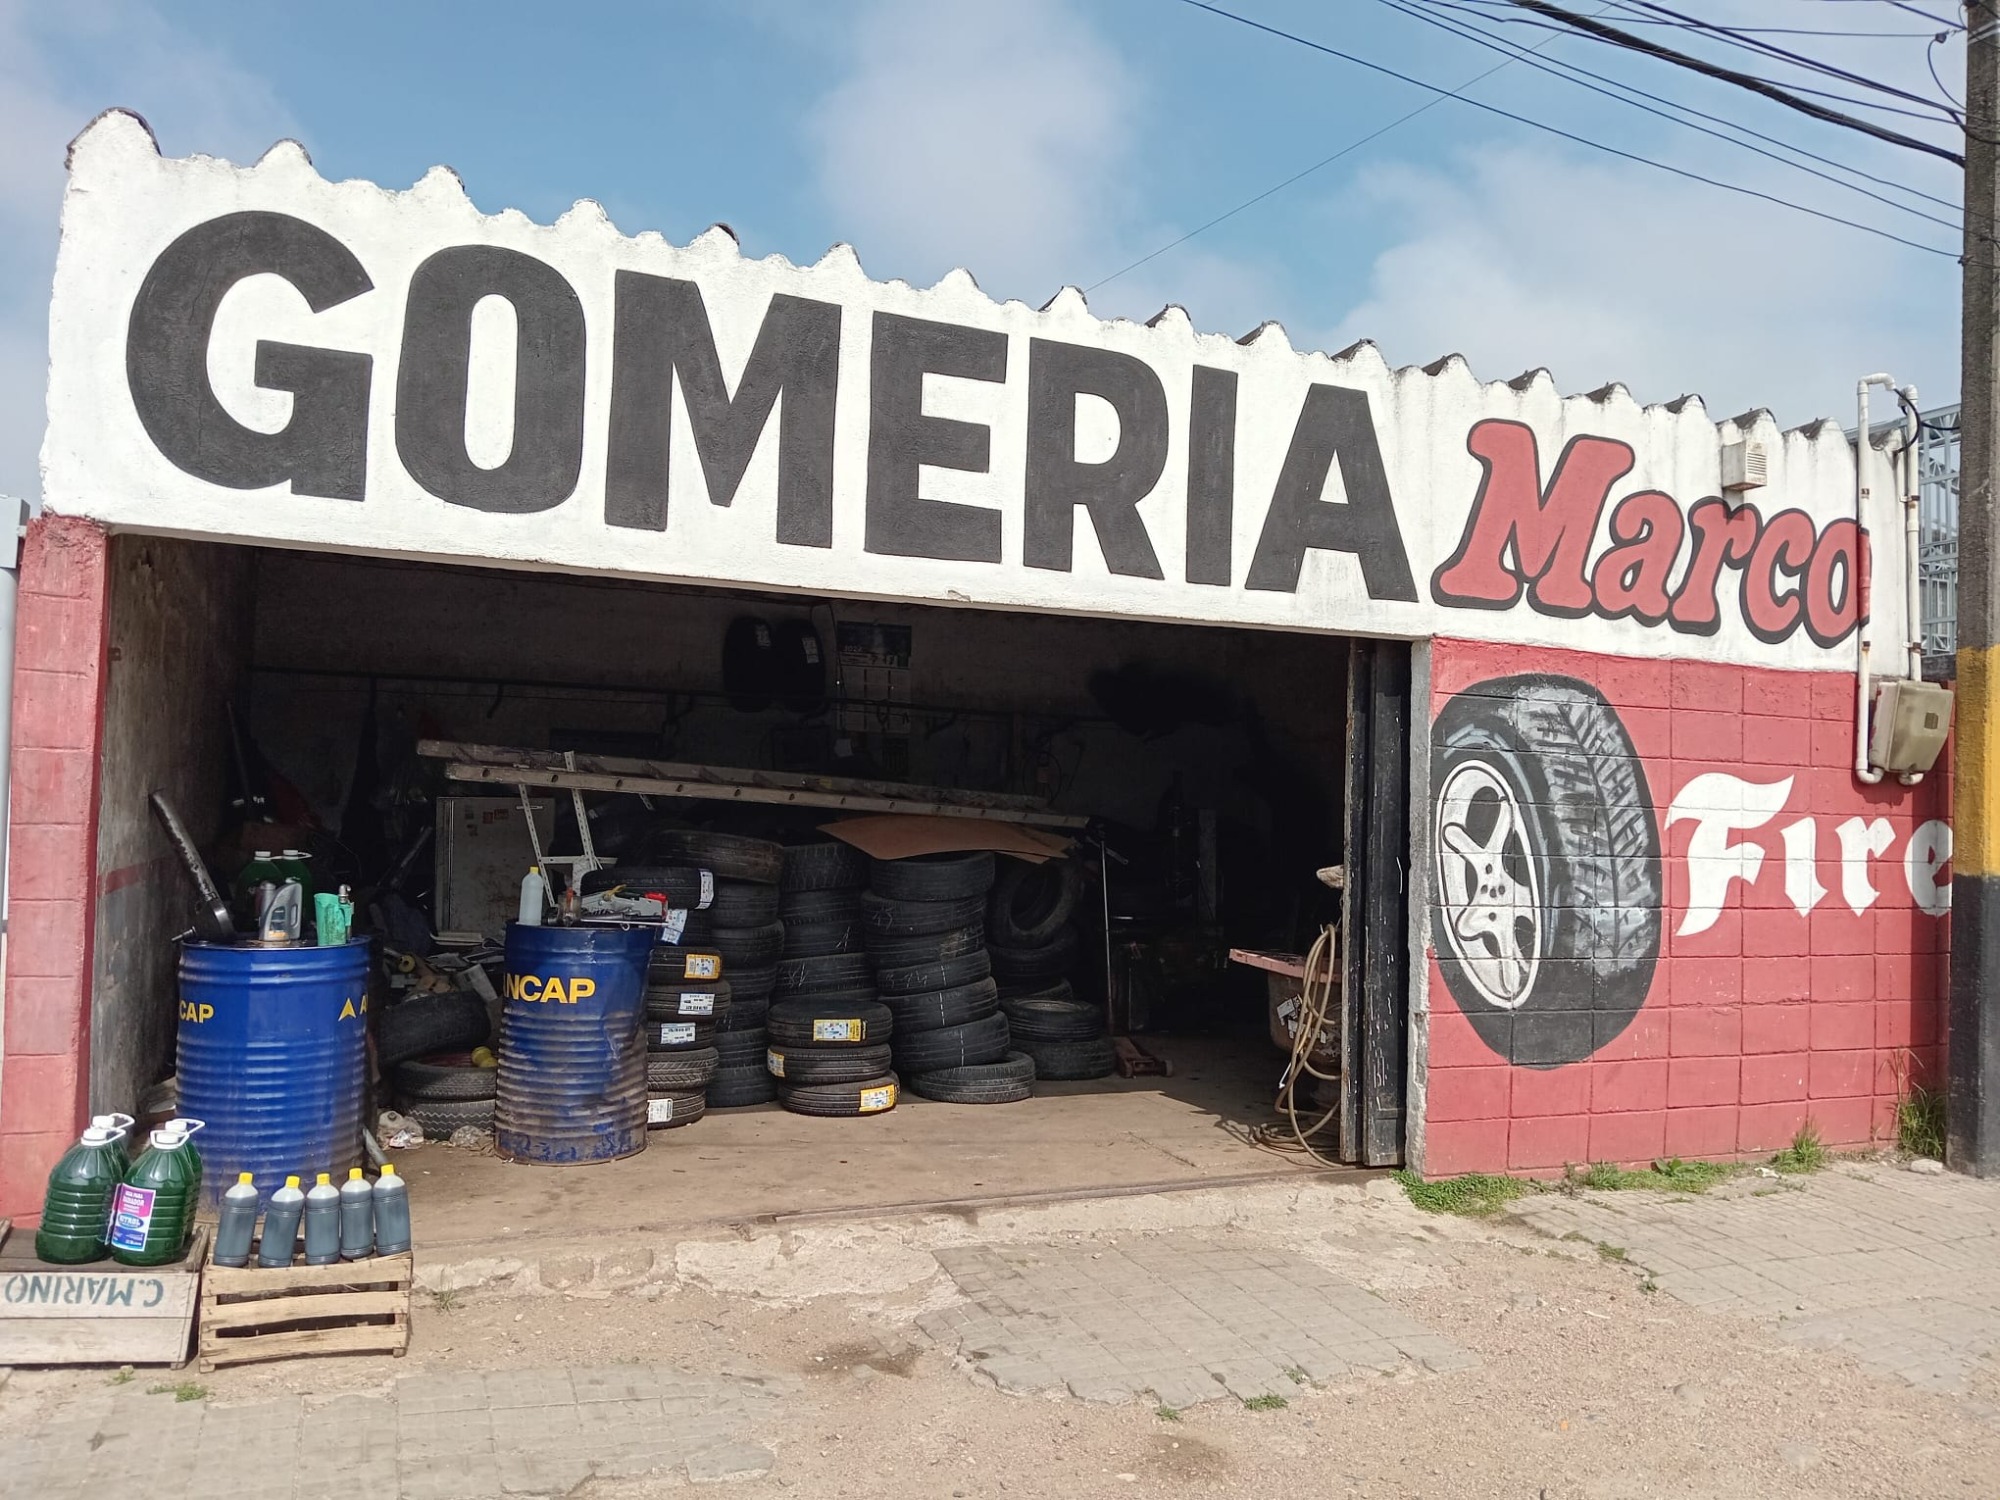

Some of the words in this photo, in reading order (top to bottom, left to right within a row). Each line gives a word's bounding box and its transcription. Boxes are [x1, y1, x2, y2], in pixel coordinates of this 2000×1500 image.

[126, 210, 1419, 602] GOMERIA
[1431, 417, 1872, 649] Marco
[1664, 772, 1953, 937] Fire
[503, 973, 596, 1004] NCAP
[5, 1274, 164, 1307] C.MARINO
